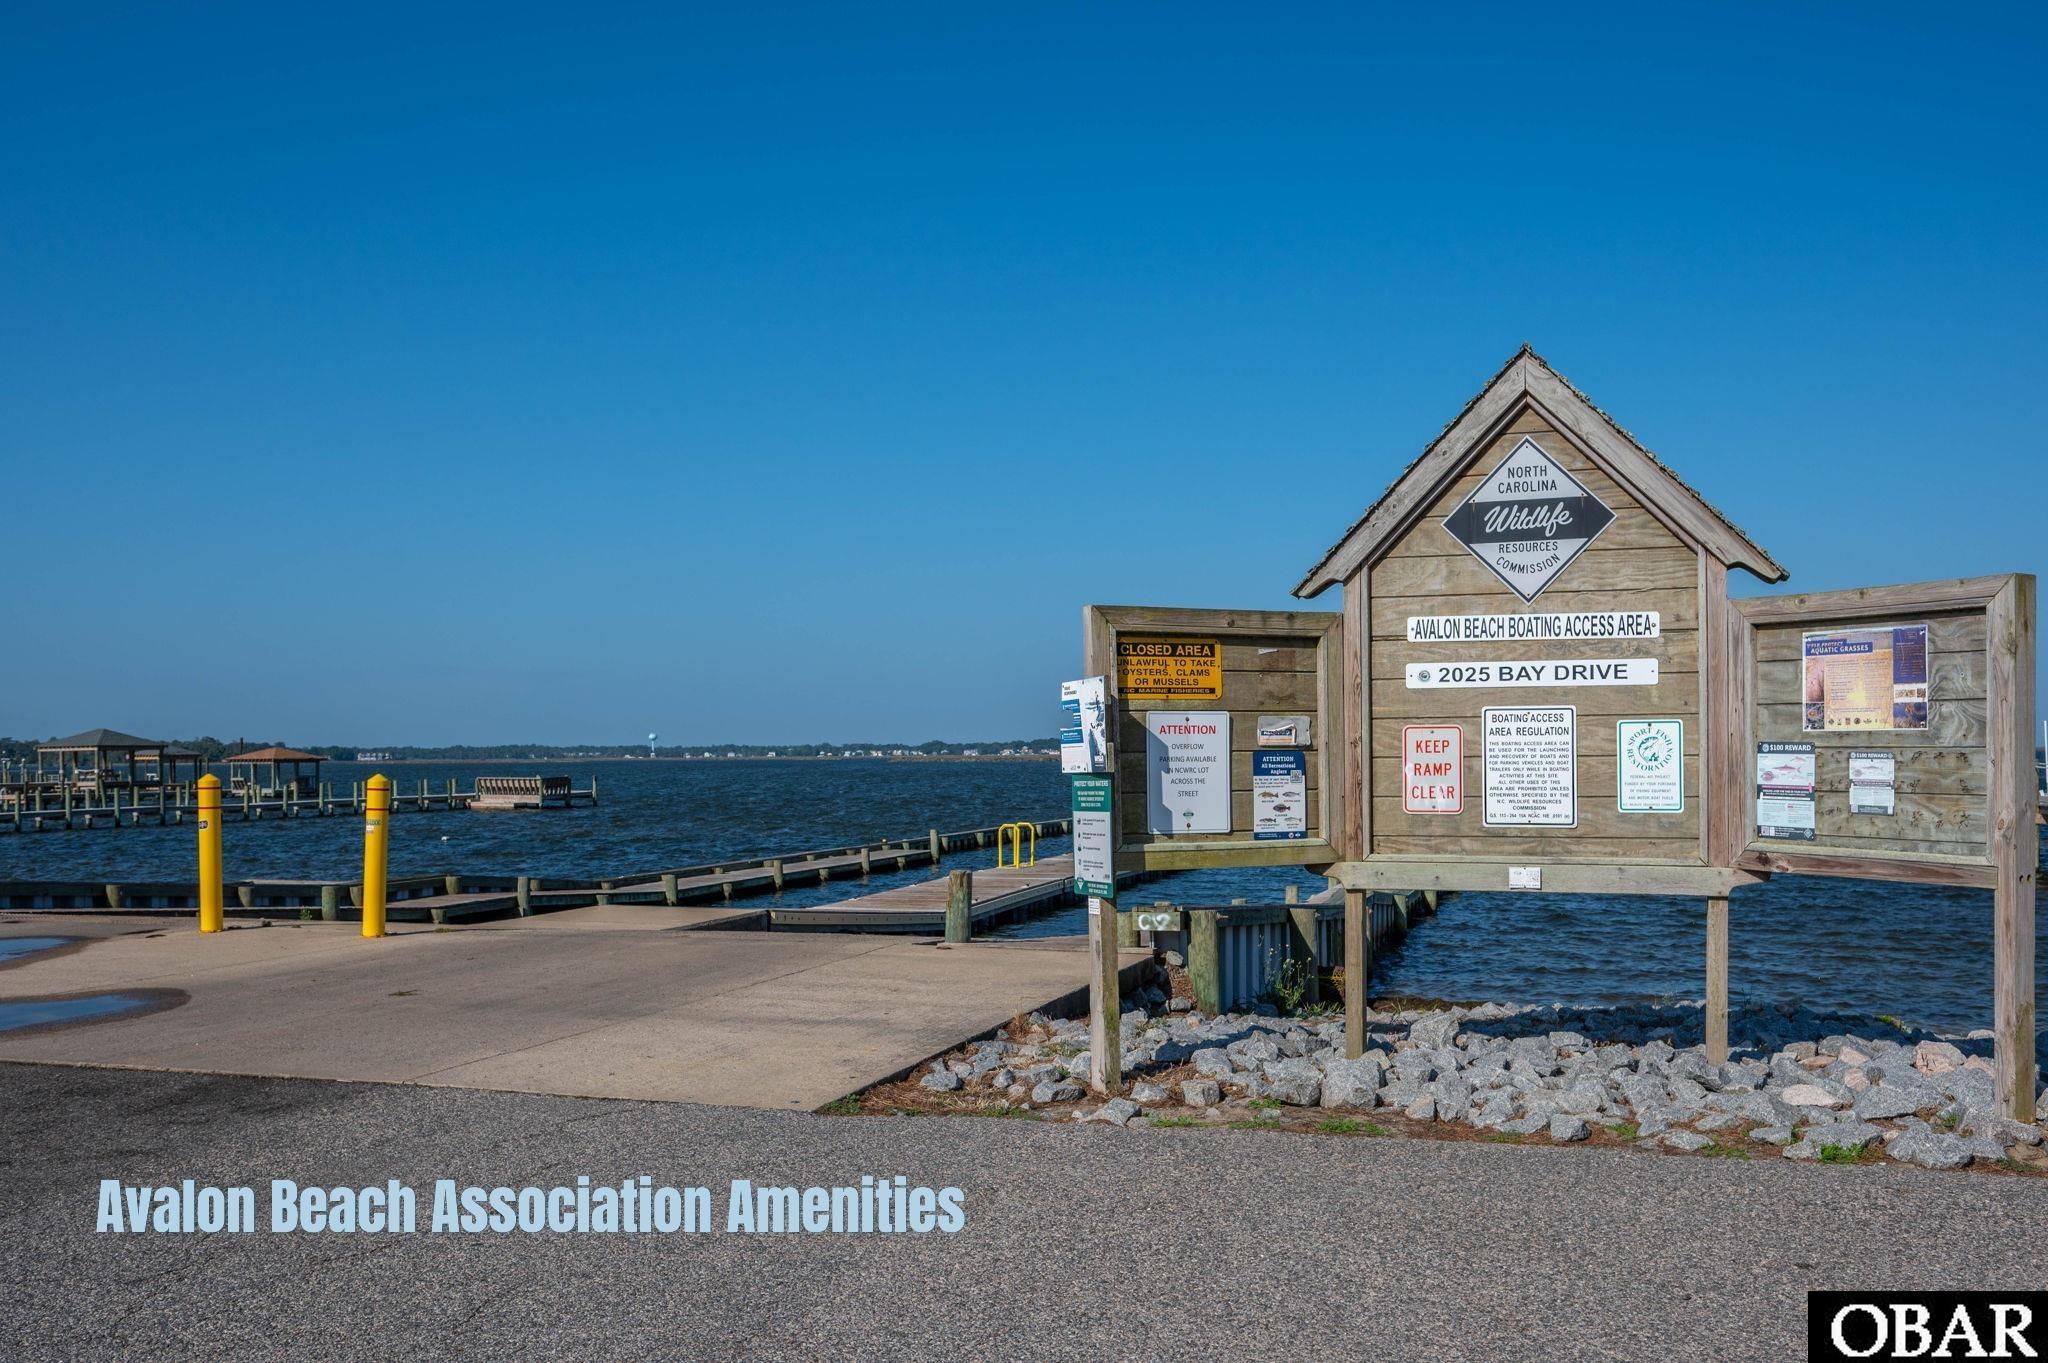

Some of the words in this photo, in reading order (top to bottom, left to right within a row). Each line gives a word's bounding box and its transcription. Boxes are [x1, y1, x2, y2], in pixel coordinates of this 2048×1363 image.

[1508, 466, 1547, 478] NORTH
[1498, 480, 1557, 493] CAROLINA
[1484, 502, 1573, 537] Wildlife
[1499, 541, 1558, 553] RESOURCES
[1496, 554, 1560, 574] COMMISSION
[1414, 619, 1460, 639] AVALON
[1464, 617, 1504, 638] BEACH
[1509, 616, 1561, 637] BOATING
[1565, 615, 1614, 636] ACCESS
[1618, 614, 1652, 636] AREA
[1121, 644, 1171, 655] CLOSED
[1176, 645, 1211, 656] AREA
[1439, 667, 1490, 682] 2025
[1499, 666, 1546, 681] BAY
[1555, 664, 1628, 680] DRIVE
[1492, 714, 1528, 722] BOATING
[1530, 713, 1564, 722] ACCESS
[1160, 725, 1216, 735] ATTENTION
[1489, 728, 1512, 736] AREA
[1516, 727, 1569, 736] REGULATION
[1628, 727, 1652, 746] SPORT
[1656, 729, 1673, 746] FISH
[1416, 740, 1450, 754] KEEP
[1627, 748, 1673, 772] RESTORATION
[1414, 763, 1452, 776] RAMP
